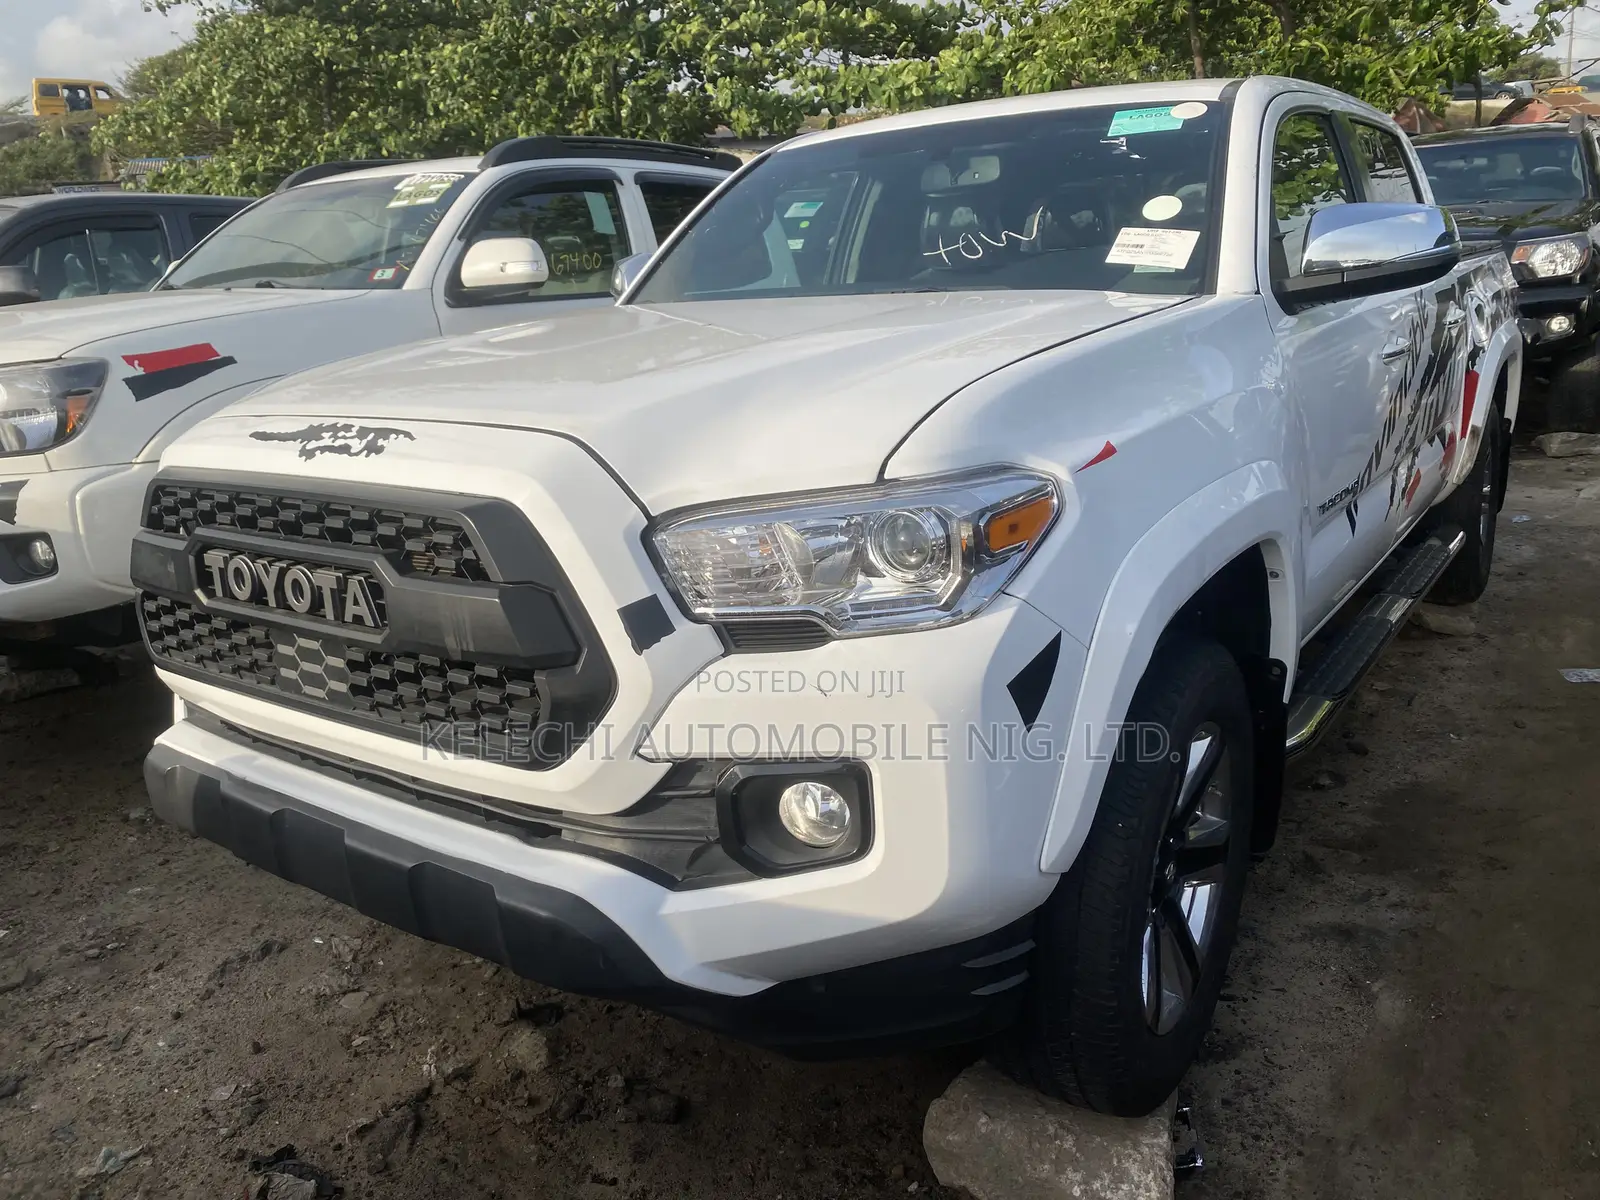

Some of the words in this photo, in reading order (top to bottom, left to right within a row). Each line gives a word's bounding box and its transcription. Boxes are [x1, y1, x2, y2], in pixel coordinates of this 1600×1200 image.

[1128, 111, 1171, 121] LAGOS
[395, 188, 442, 202] LAGOS
[551, 252, 602, 275] 67400
[377, 269, 386, 278] 3
[203, 550, 381, 628] TOYOTA
